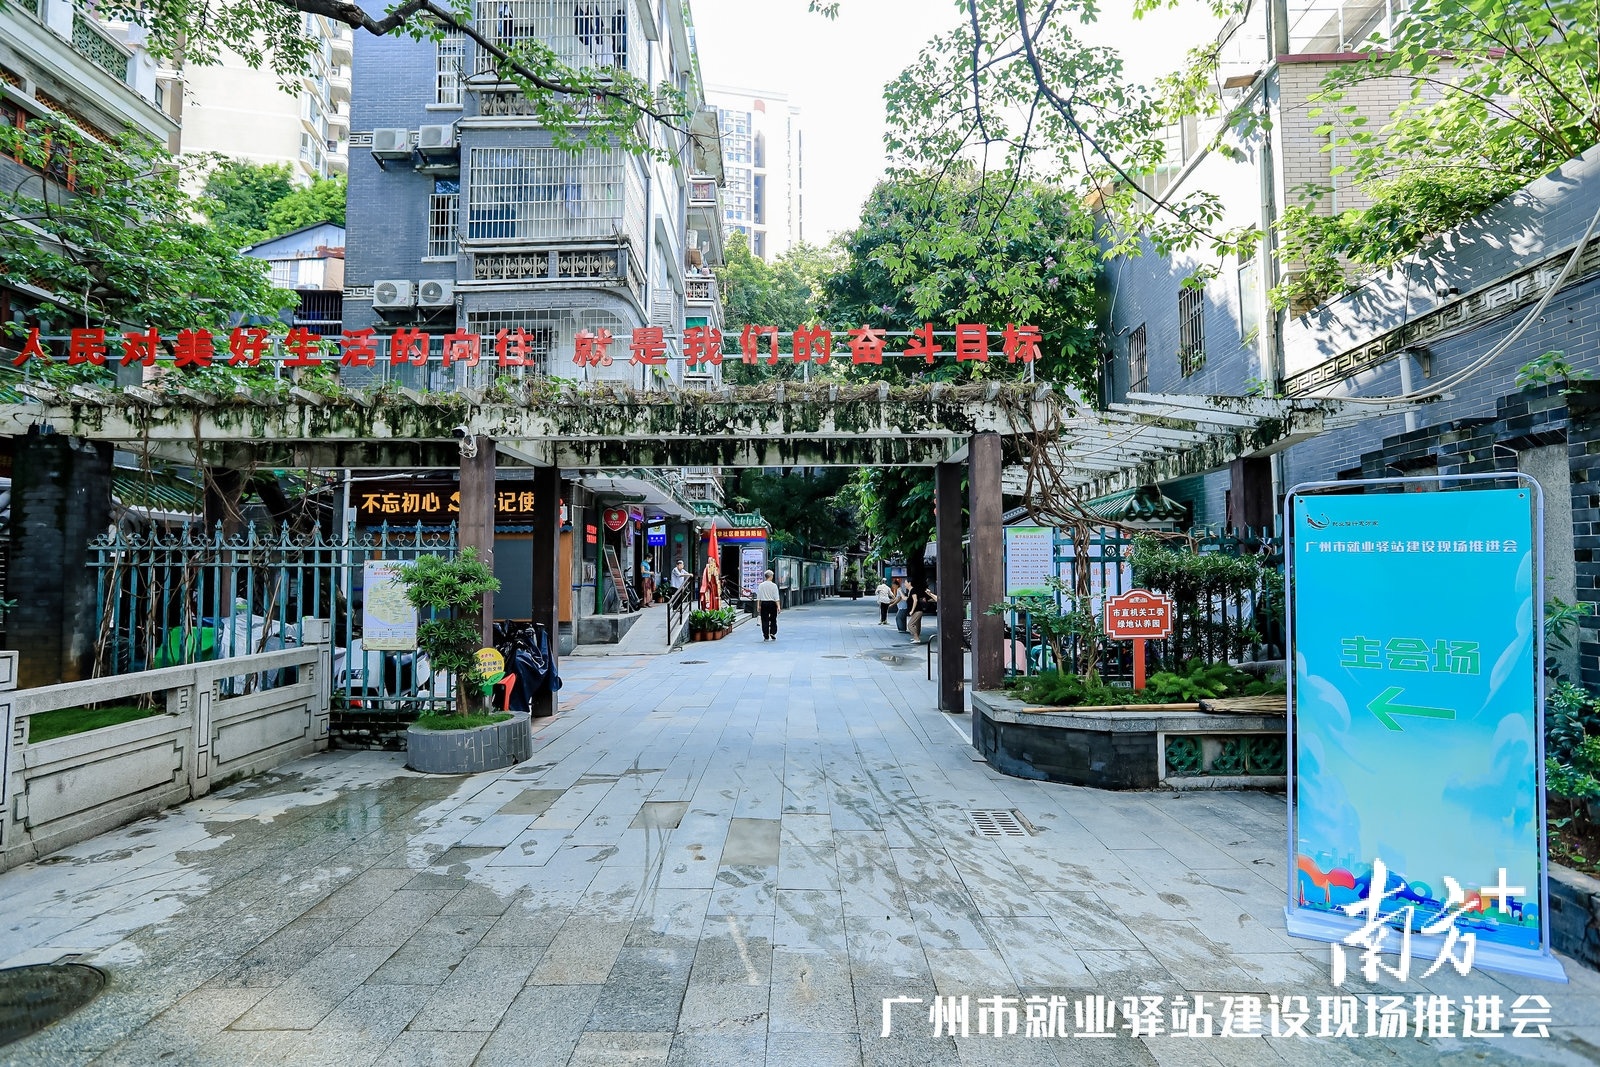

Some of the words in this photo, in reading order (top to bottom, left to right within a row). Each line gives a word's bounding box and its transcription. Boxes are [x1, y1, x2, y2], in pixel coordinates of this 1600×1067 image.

[13, 326, 534, 368] 人民对美好生活的向往
[573, 323, 1043, 367] 就是我们的奋斗目标
[361, 492, 441, 514] 不忘初心
[1305, 540, 1518, 553] 广州市就业驿站建设现场推进会
[1112, 607, 1165, 617] 市直机关工委
[1116, 619, 1161, 629] 绿地认养园
[1340, 635, 1481, 676] 主会场
